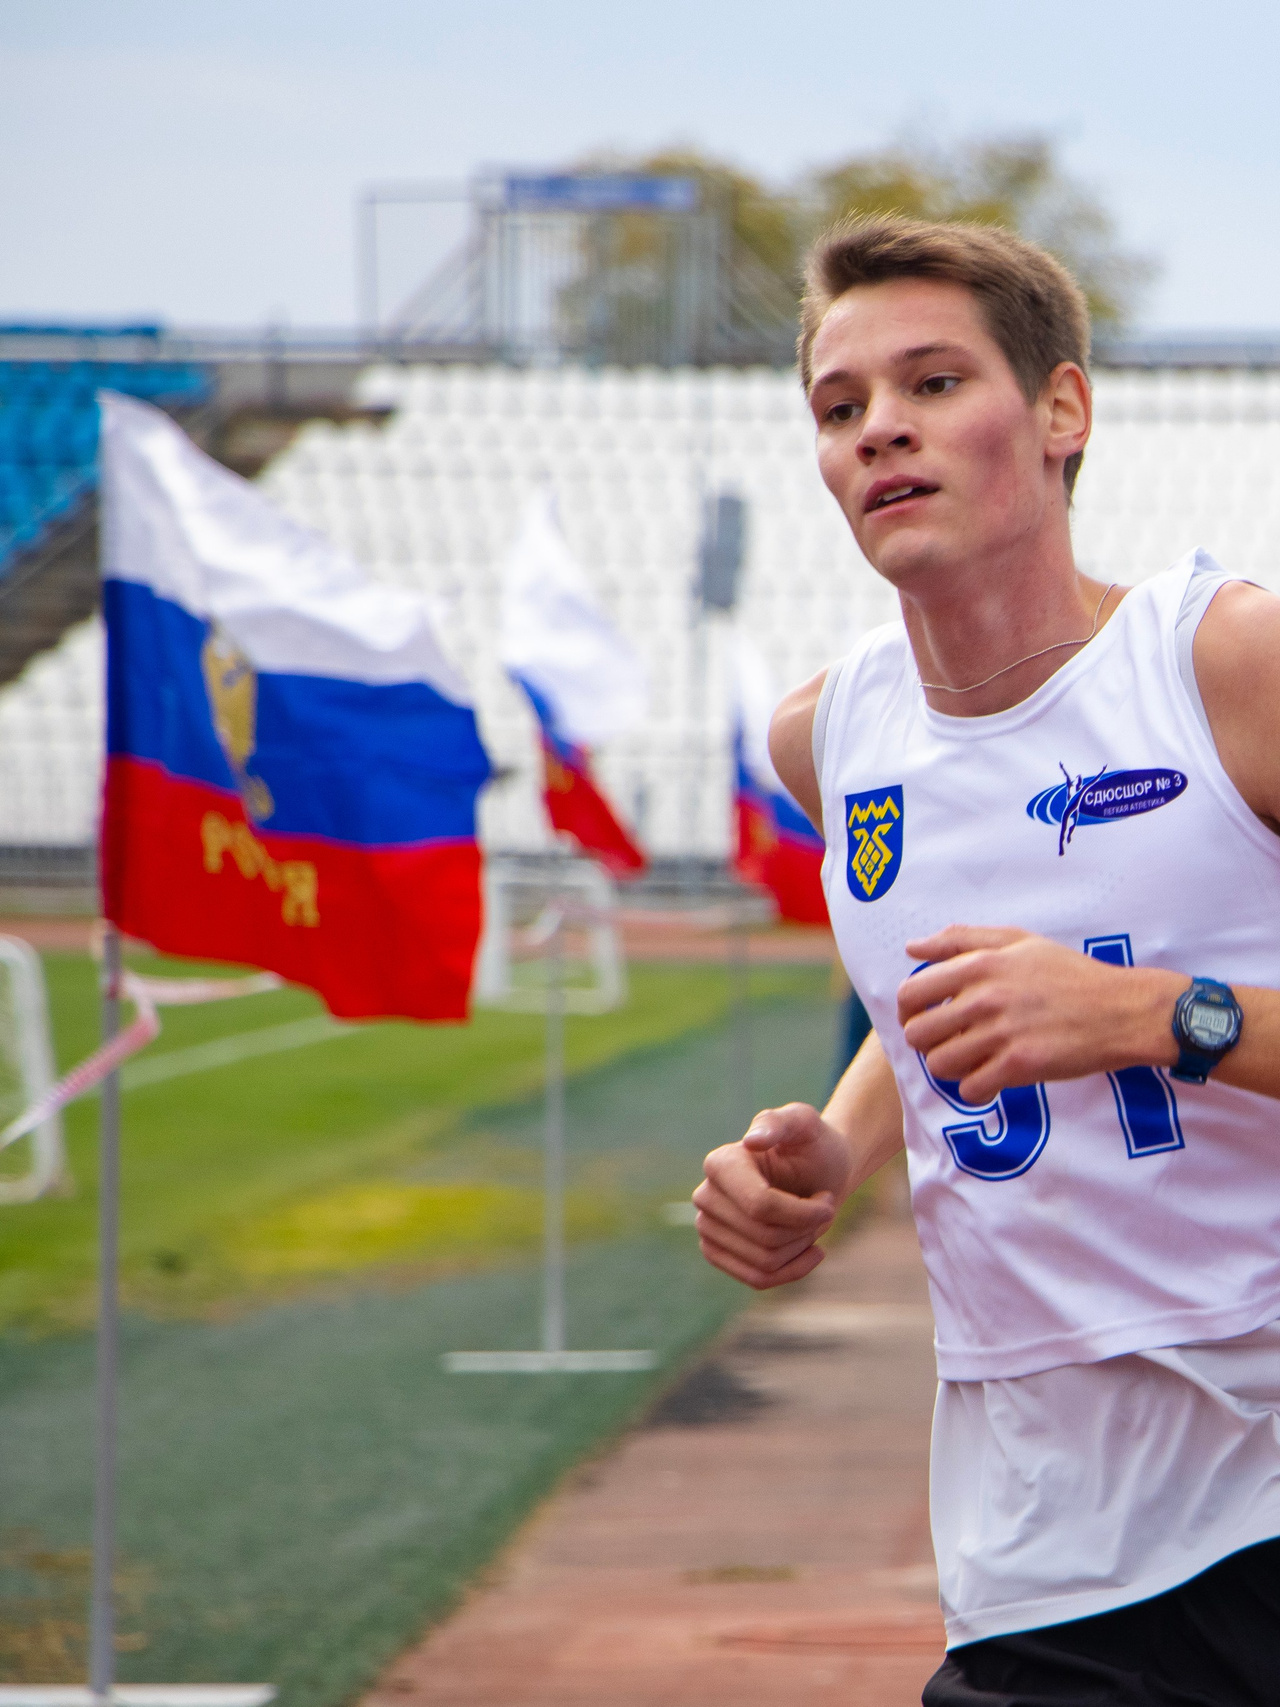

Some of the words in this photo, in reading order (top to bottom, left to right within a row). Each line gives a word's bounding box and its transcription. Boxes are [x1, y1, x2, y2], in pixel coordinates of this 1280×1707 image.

[1084, 780, 1152, 806] СДЮСШОР
[1173, 773, 1182, 787] 3
[1103, 803, 1129, 816] ЛЕГКАЯ
[1129, 797, 1165, 811] АТЛЕТИКА
